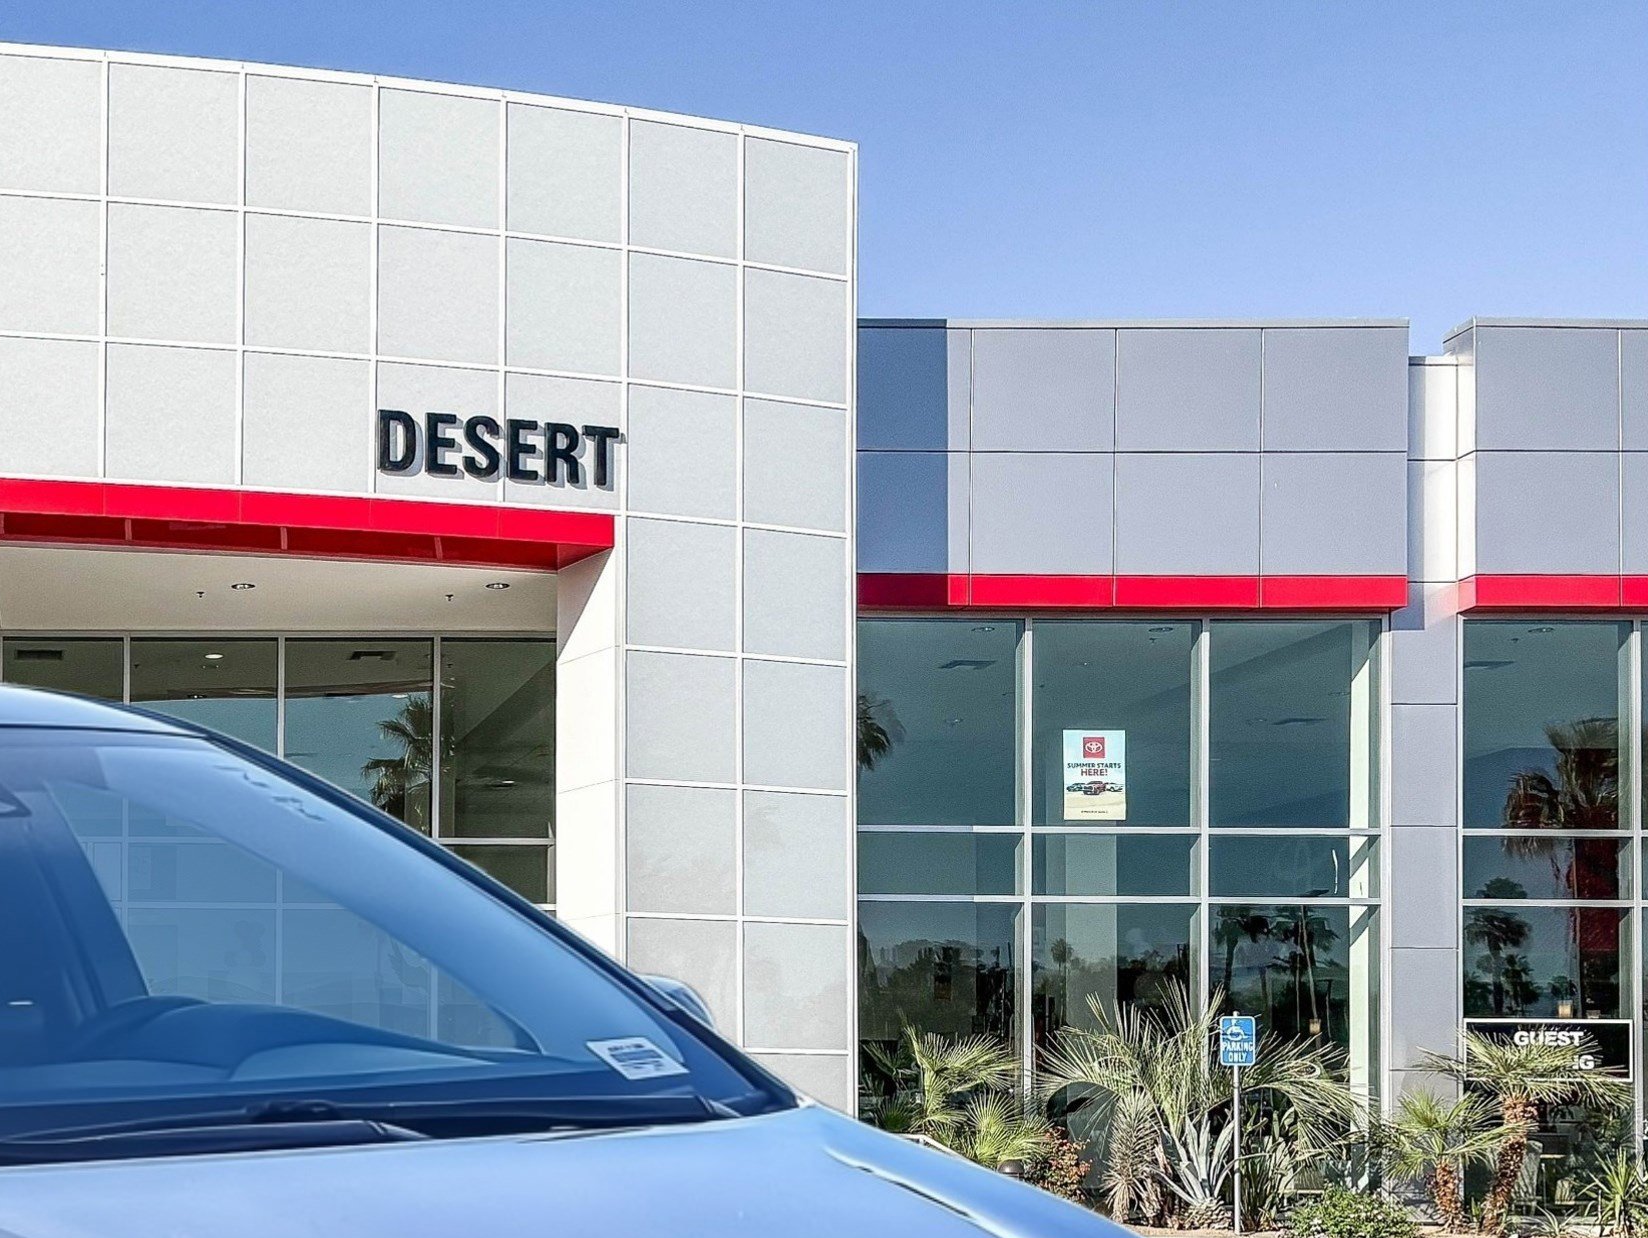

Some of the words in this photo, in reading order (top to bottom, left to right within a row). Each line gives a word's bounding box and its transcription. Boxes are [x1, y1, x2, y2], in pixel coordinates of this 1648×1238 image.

[377, 409, 620, 487] DESERT
[1080, 768, 1108, 777] HERE!
[1513, 1030, 1585, 1047] GUEST
[1222, 1041, 1254, 1051] PARKING
[1228, 1051, 1248, 1063] ONLY
